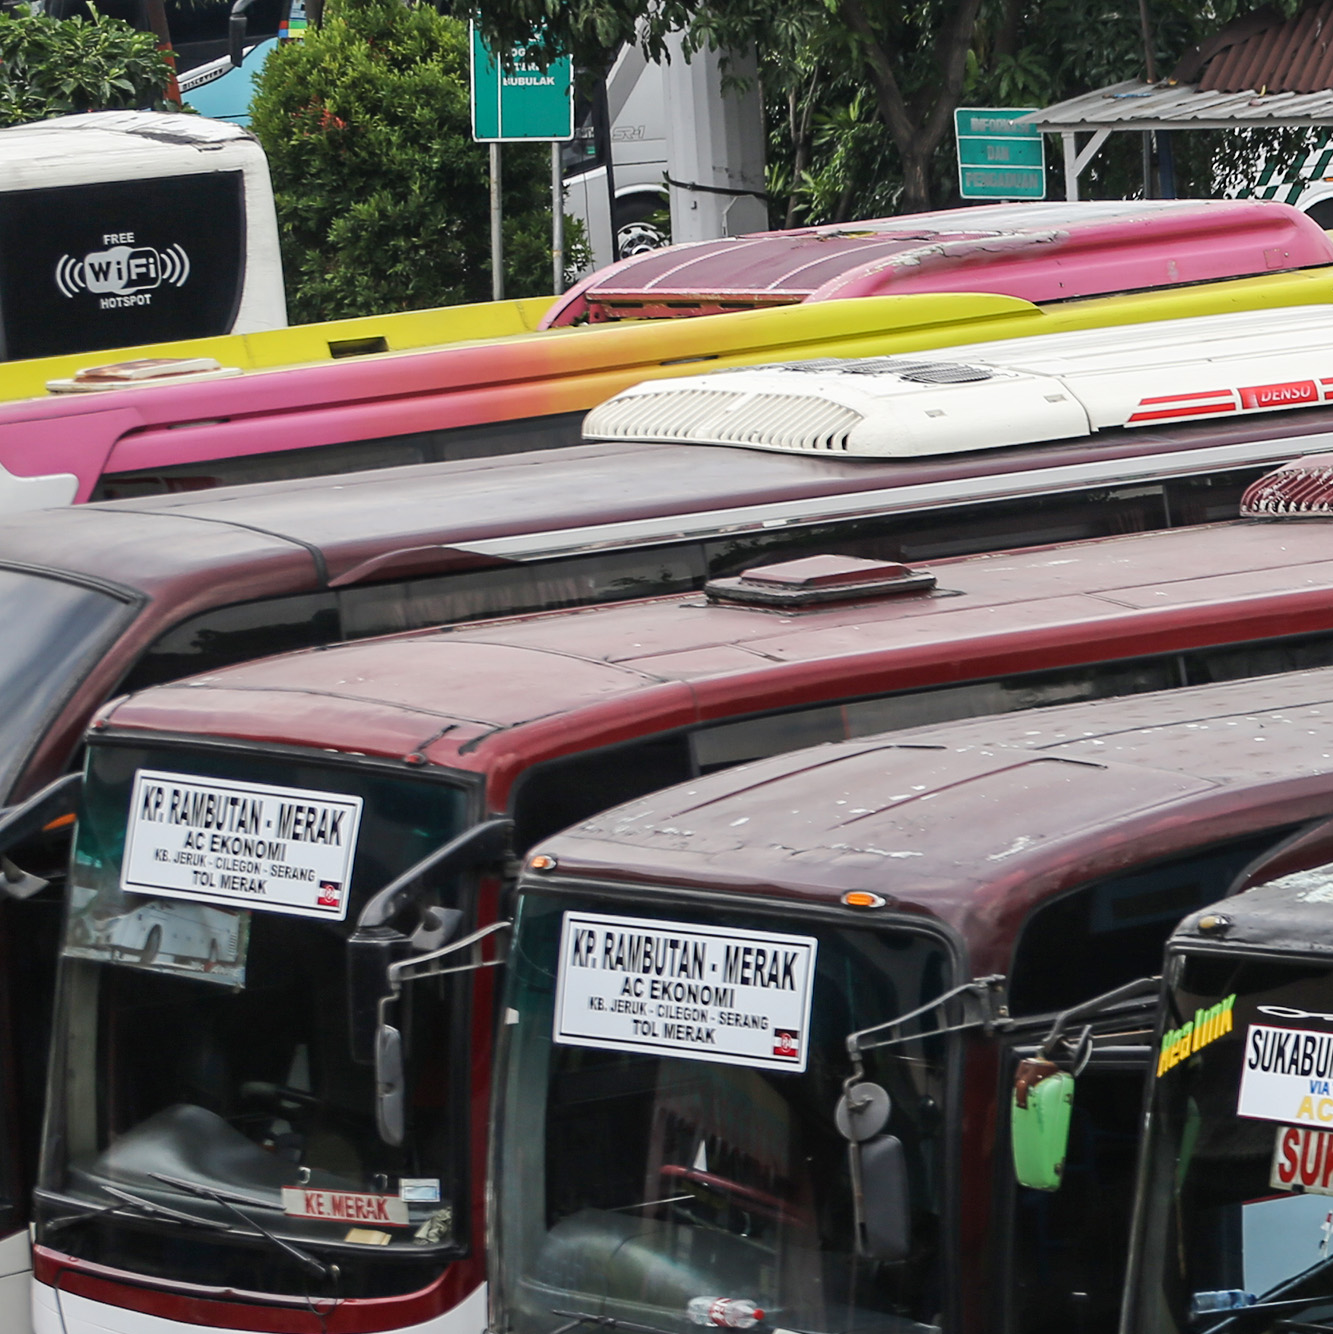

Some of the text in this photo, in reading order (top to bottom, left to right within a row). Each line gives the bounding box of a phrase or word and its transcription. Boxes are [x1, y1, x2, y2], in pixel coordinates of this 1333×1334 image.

[103, 232, 135, 245] FREE
[88, 257, 157, 283] WiFi
[100, 294, 152, 310] HOTSPOT
[1260, 385, 1311, 402] DENSO
[141, 785, 165, 823] KP.
[168, 789, 264, 836] RAMBUTAN
[277, 803, 347, 847] MERAK
[184, 831, 288, 862] AC EKONOMI
[153, 848, 171, 863] KB.
[173, 851, 207, 868] JERUK
[215, 858, 263, 875] CILEGON
[270, 866, 316, 882] SERANG
[193, 870, 267, 895] TOL MERAK
[572, 928, 597, 969] KP.
[602, 931, 707, 981] RAMBUTAN
[723, 944, 799, 991] MERAK
[620, 977, 735, 1009] AC EKONOMI
[589, 996, 608, 1012] KB.
[610, 999, 647, 1016] JERUK
[656, 1004, 709, 1024] CILEGON
[718, 1013, 769, 1031] SERANG
[632, 1019, 717, 1045] TOL MERAK
[1309, 1080, 1330, 1096] VIA
